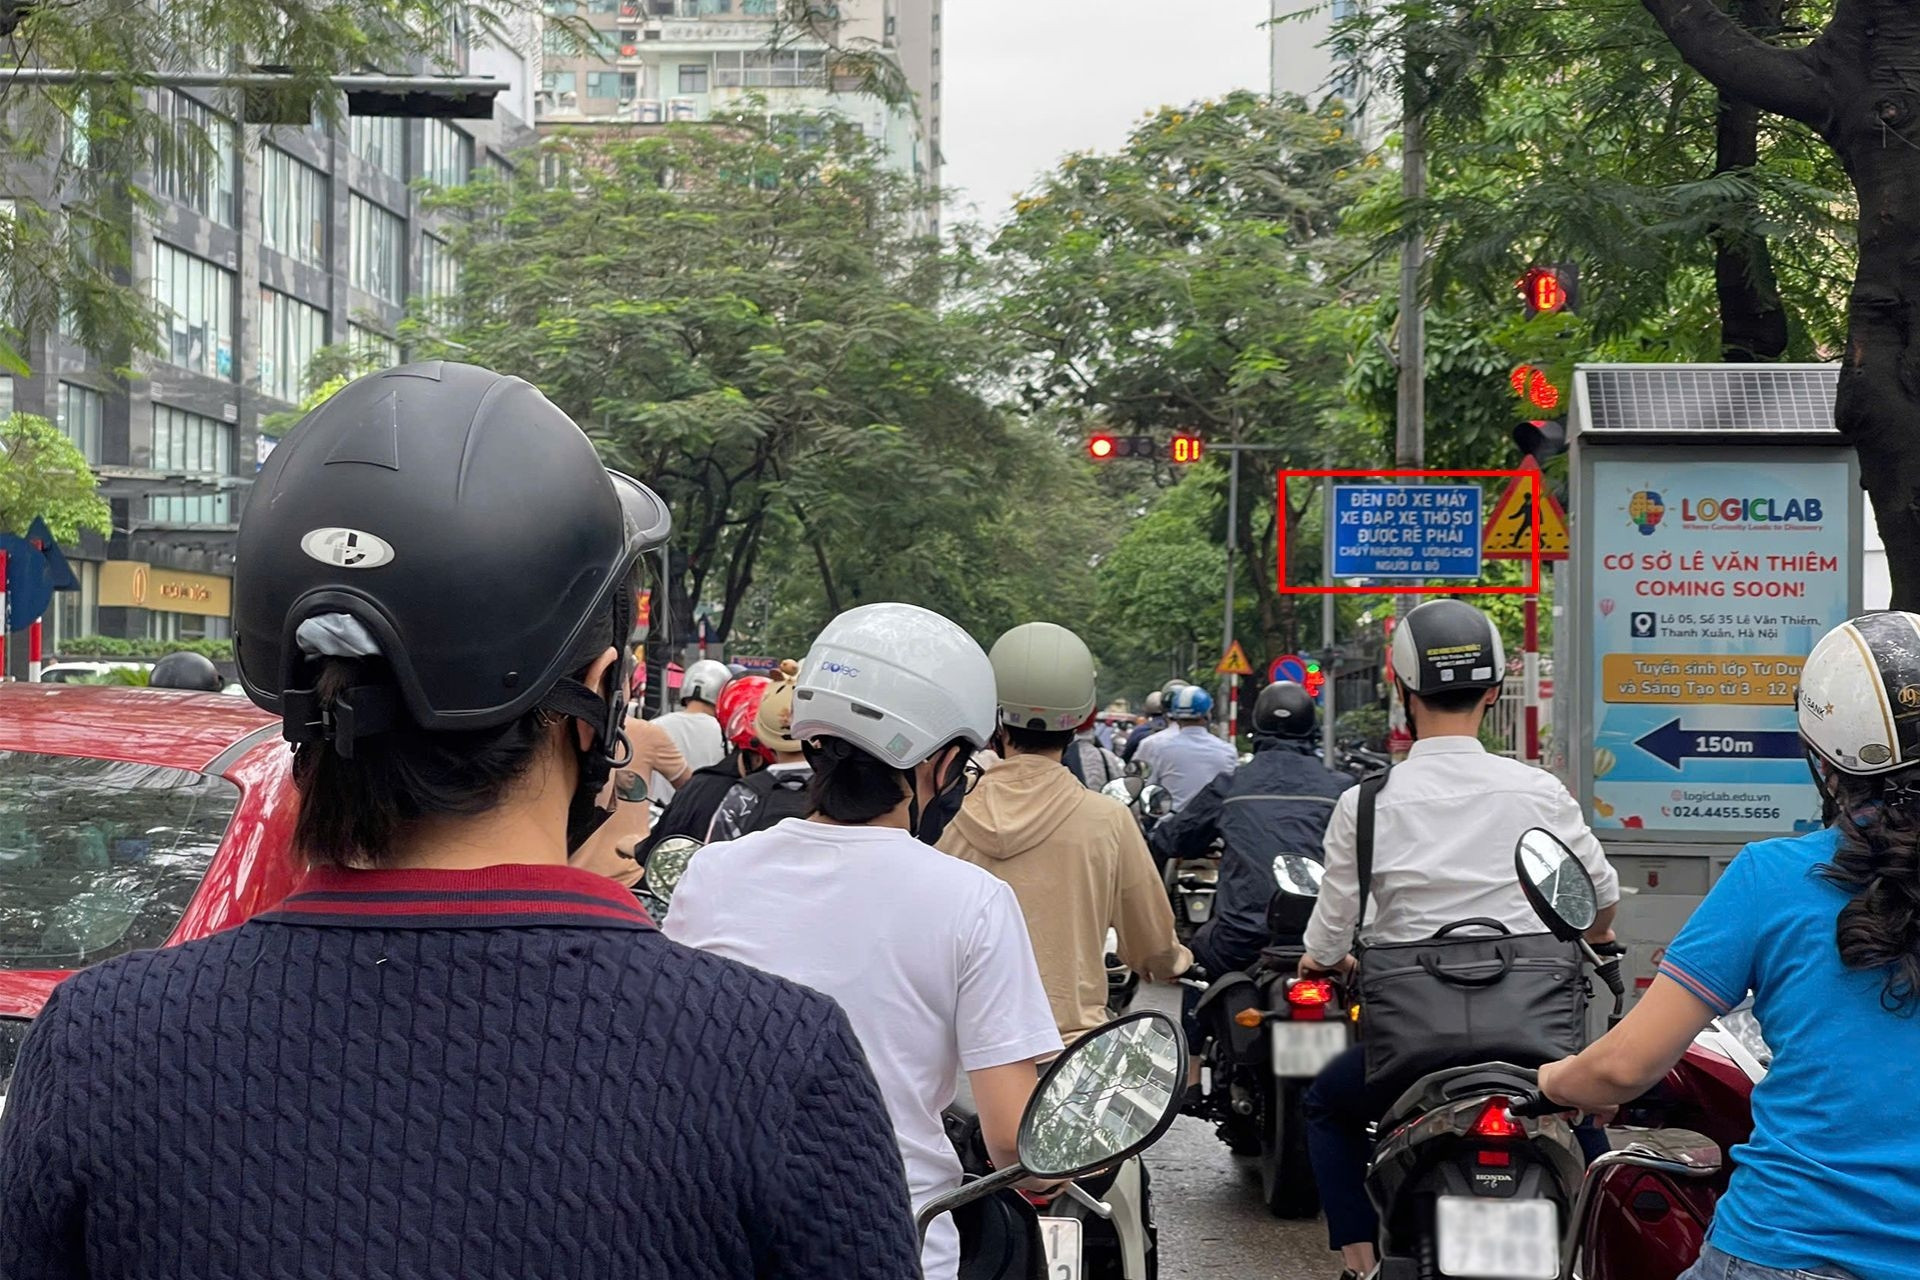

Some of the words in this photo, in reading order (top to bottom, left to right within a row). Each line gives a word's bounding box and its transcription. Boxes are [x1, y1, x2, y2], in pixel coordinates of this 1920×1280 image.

[1174, 438, 1199, 462] 01
[1386, 488, 1407, 507] ĐỎ
[1412, 493, 1433, 507] XE
[1435, 489, 1468, 507] MÁY
[1340, 511, 1360, 524] XE
[1398, 511, 1418, 524] XE
[1452, 510, 1473, 525] SƠ
[1681, 498, 1824, 522] LOGICLAB
[1358, 528, 1399, 545] ĐƯỢC
[1426, 524, 1463, 542] PHẢI
[1452, 547, 1474, 557] CHO
[1603, 552, 1634, 570] CƠ
[1642, 550, 1673, 571] SỞ
[1680, 551, 1704, 571] LÊ
[1712, 551, 1759, 571] VĂN
[1766, 551, 1838, 572] THIÊM
[1635, 580, 1725, 597] COMING
[1733, 580, 1805, 597] SOON!
[1661, 614, 1675, 624] Lô
[1678, 614, 1696, 626] 05,
[1700, 613, 1715, 625] Số
[1719, 615, 1733, 625] 35
[1737, 614, 1750, 625] Lê
[1754, 614, 1777, 625] Văn
[1780, 614, 1821, 626] Thiêm,
[1661, 628, 1698, 638] Thanh
[1701, 628, 1735, 639] Xuân,
[1738, 628, 1754, 638] Hà
[1758, 629, 1778, 640] Nội
[1633, 660, 1681, 677] Tuyển
[1684, 662, 1717, 675] sinh
[1722, 662, 1747, 678] lớp
[1752, 663, 1772, 676] Tư
[1618, 682, 1637, 694] và
[1641, 679, 1681, 697] Sáng
[1686, 681, 1715, 698] Tạo
[1720, 681, 1737, 695] từ
[1741, 683, 1751, 695] 3
[1768, 684, 1787, 695] 12
[1696, 736, 1753, 753] 150m
[1684, 790, 1771, 803] logiclab.edu.vn
[1673, 806, 1780, 819] 024.4455.5656
